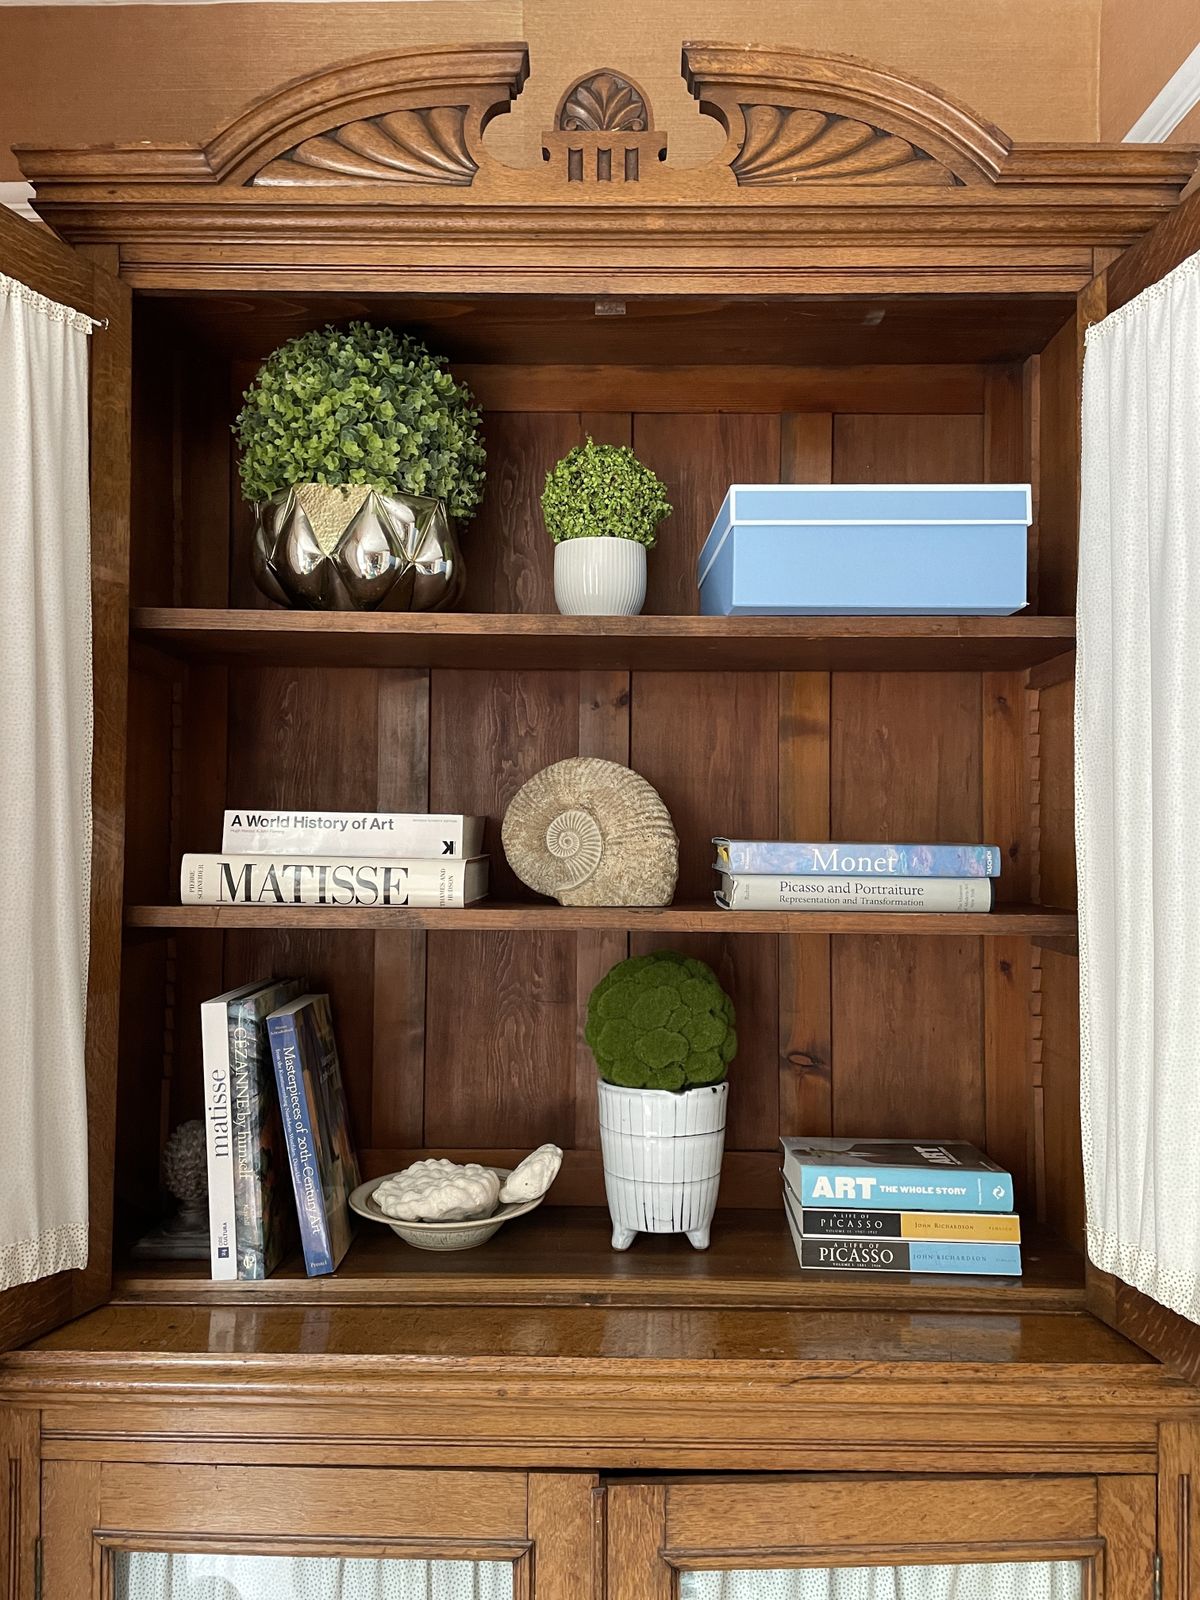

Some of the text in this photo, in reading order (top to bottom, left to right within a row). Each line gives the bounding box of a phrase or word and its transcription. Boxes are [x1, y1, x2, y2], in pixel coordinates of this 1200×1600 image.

[231, 814, 394, 832] A World History of Art
[811, 848, 897, 872] Monet
[216, 863, 408, 905] MATISSE
[780, 881, 925, 896] Picasso and Portraiture
[779, 895, 924, 907] Representation and Transformation
[209, 1069, 229, 1157] matisse
[233, 1027, 254, 1179] CÉZANNE by himself
[283, 1046, 322, 1235] Masterpieces of 20th-Century Art
[812, 1176, 967, 1199] ART THE WHOLE STORY
[820, 1219, 883, 1229] PICASSO
[934, 1222, 974, 1230] RICHARDSON
[819, 1247, 894, 1264] PICASSO
